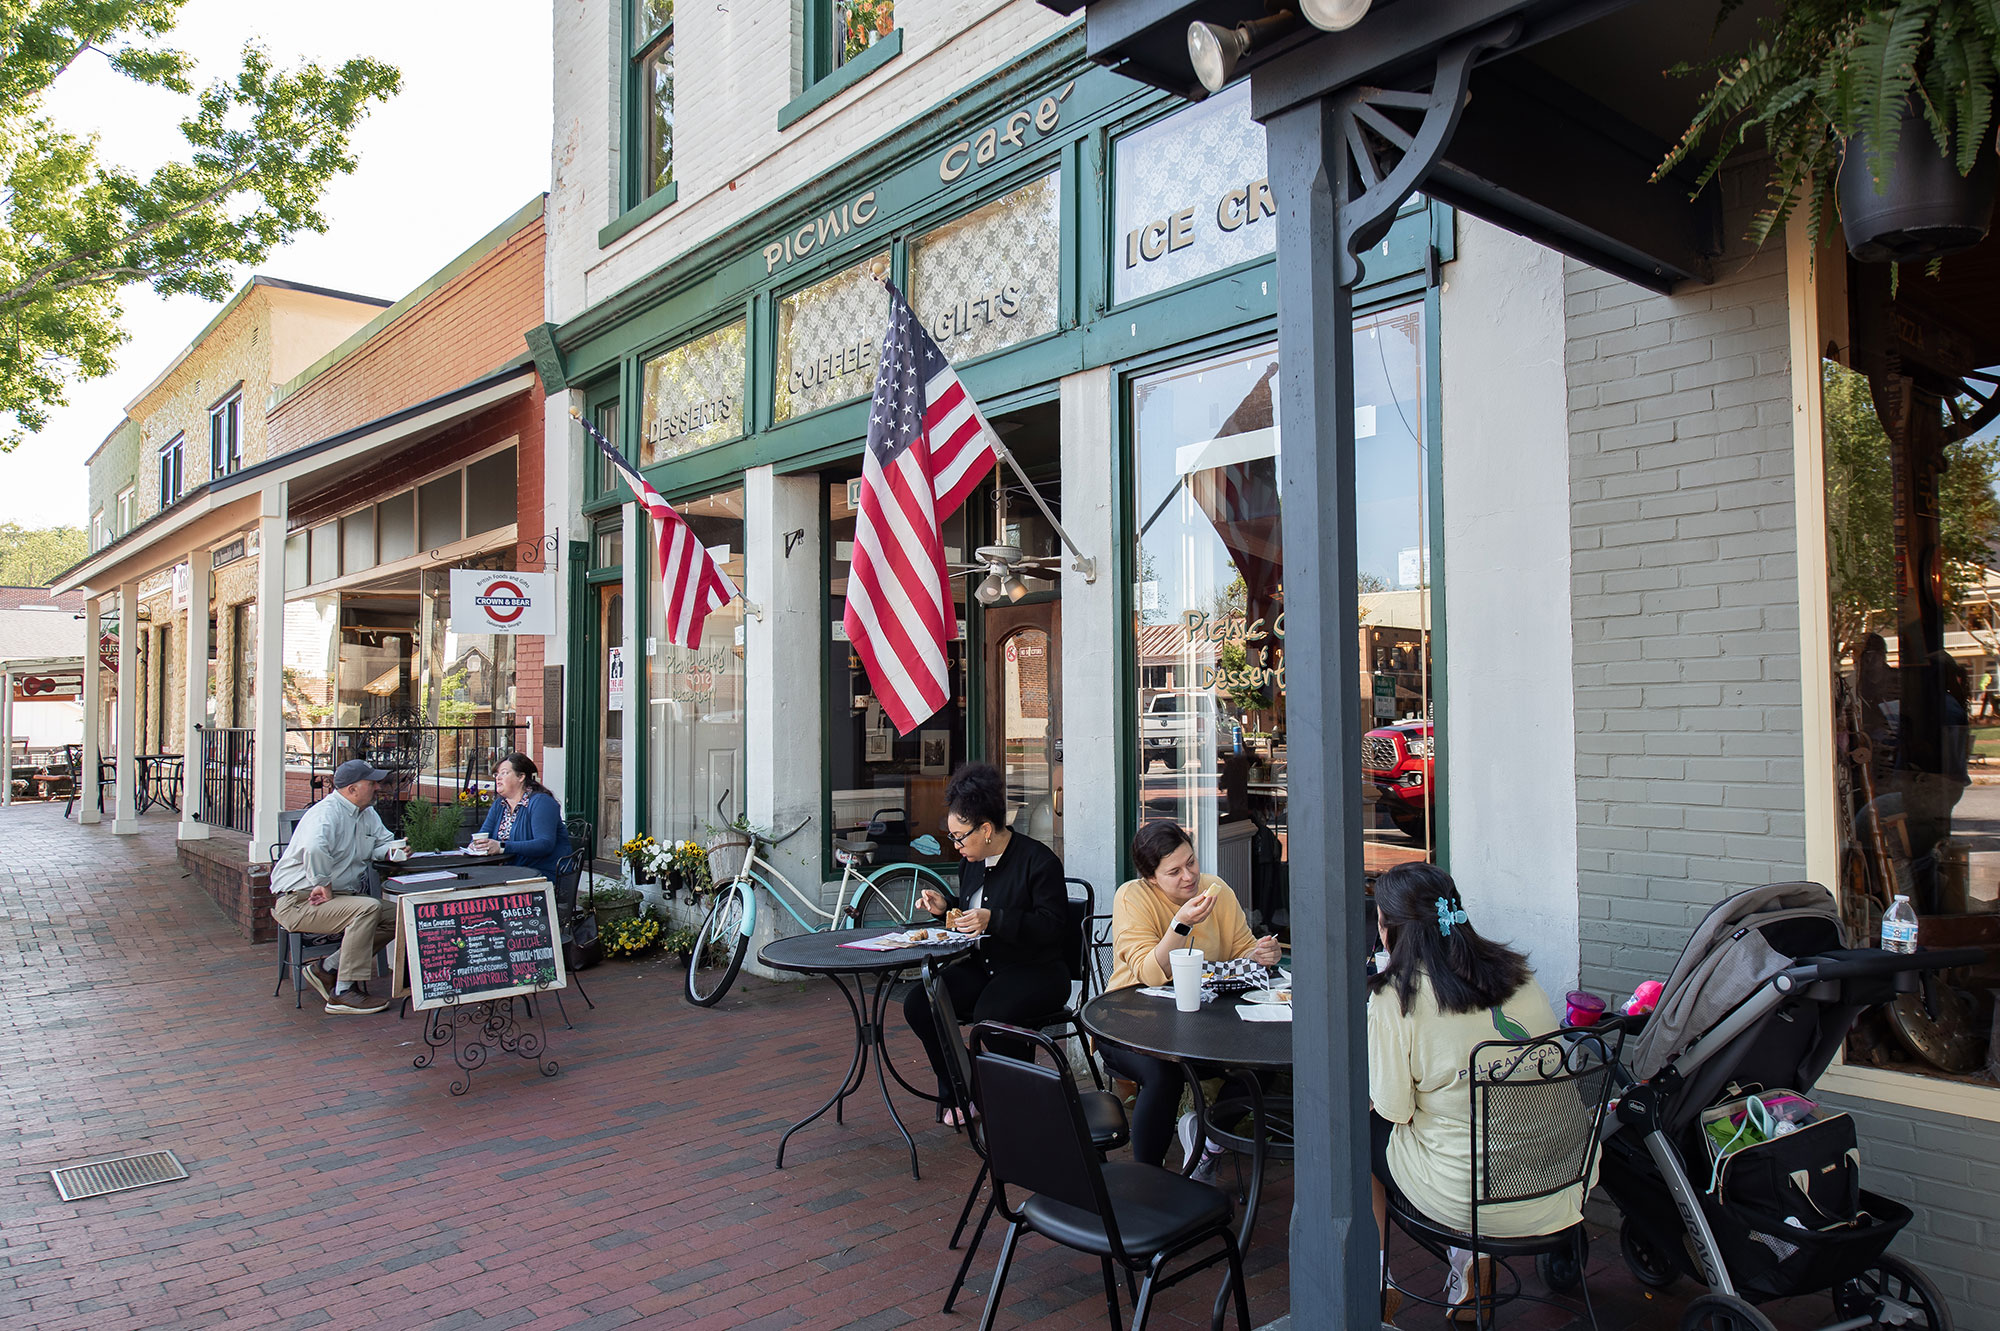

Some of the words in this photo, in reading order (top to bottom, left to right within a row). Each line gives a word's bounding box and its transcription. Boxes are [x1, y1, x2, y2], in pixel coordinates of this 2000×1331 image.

[763, 191, 878, 276] PICNIC
[1126, 205, 1195, 270] ICE
[934, 282, 1022, 343] GIFTS
[788, 339, 873, 394] COFFEE
[649, 392, 733, 444] DESSERTS
[476, 576, 492, 587] British
[518, 578, 530, 589] Gifts
[476, 597, 504, 605] CROWN
[511, 598, 530, 606] BEAR
[1183, 609, 1269, 642] Picnic
[418, 904, 440, 919] OUR
[442, 897, 500, 917] BREAKFAST
[503, 893, 532, 910] MENU
[501, 906, 532, 919] BAGELS
[1677, 1201, 1719, 1287] BRAVO
